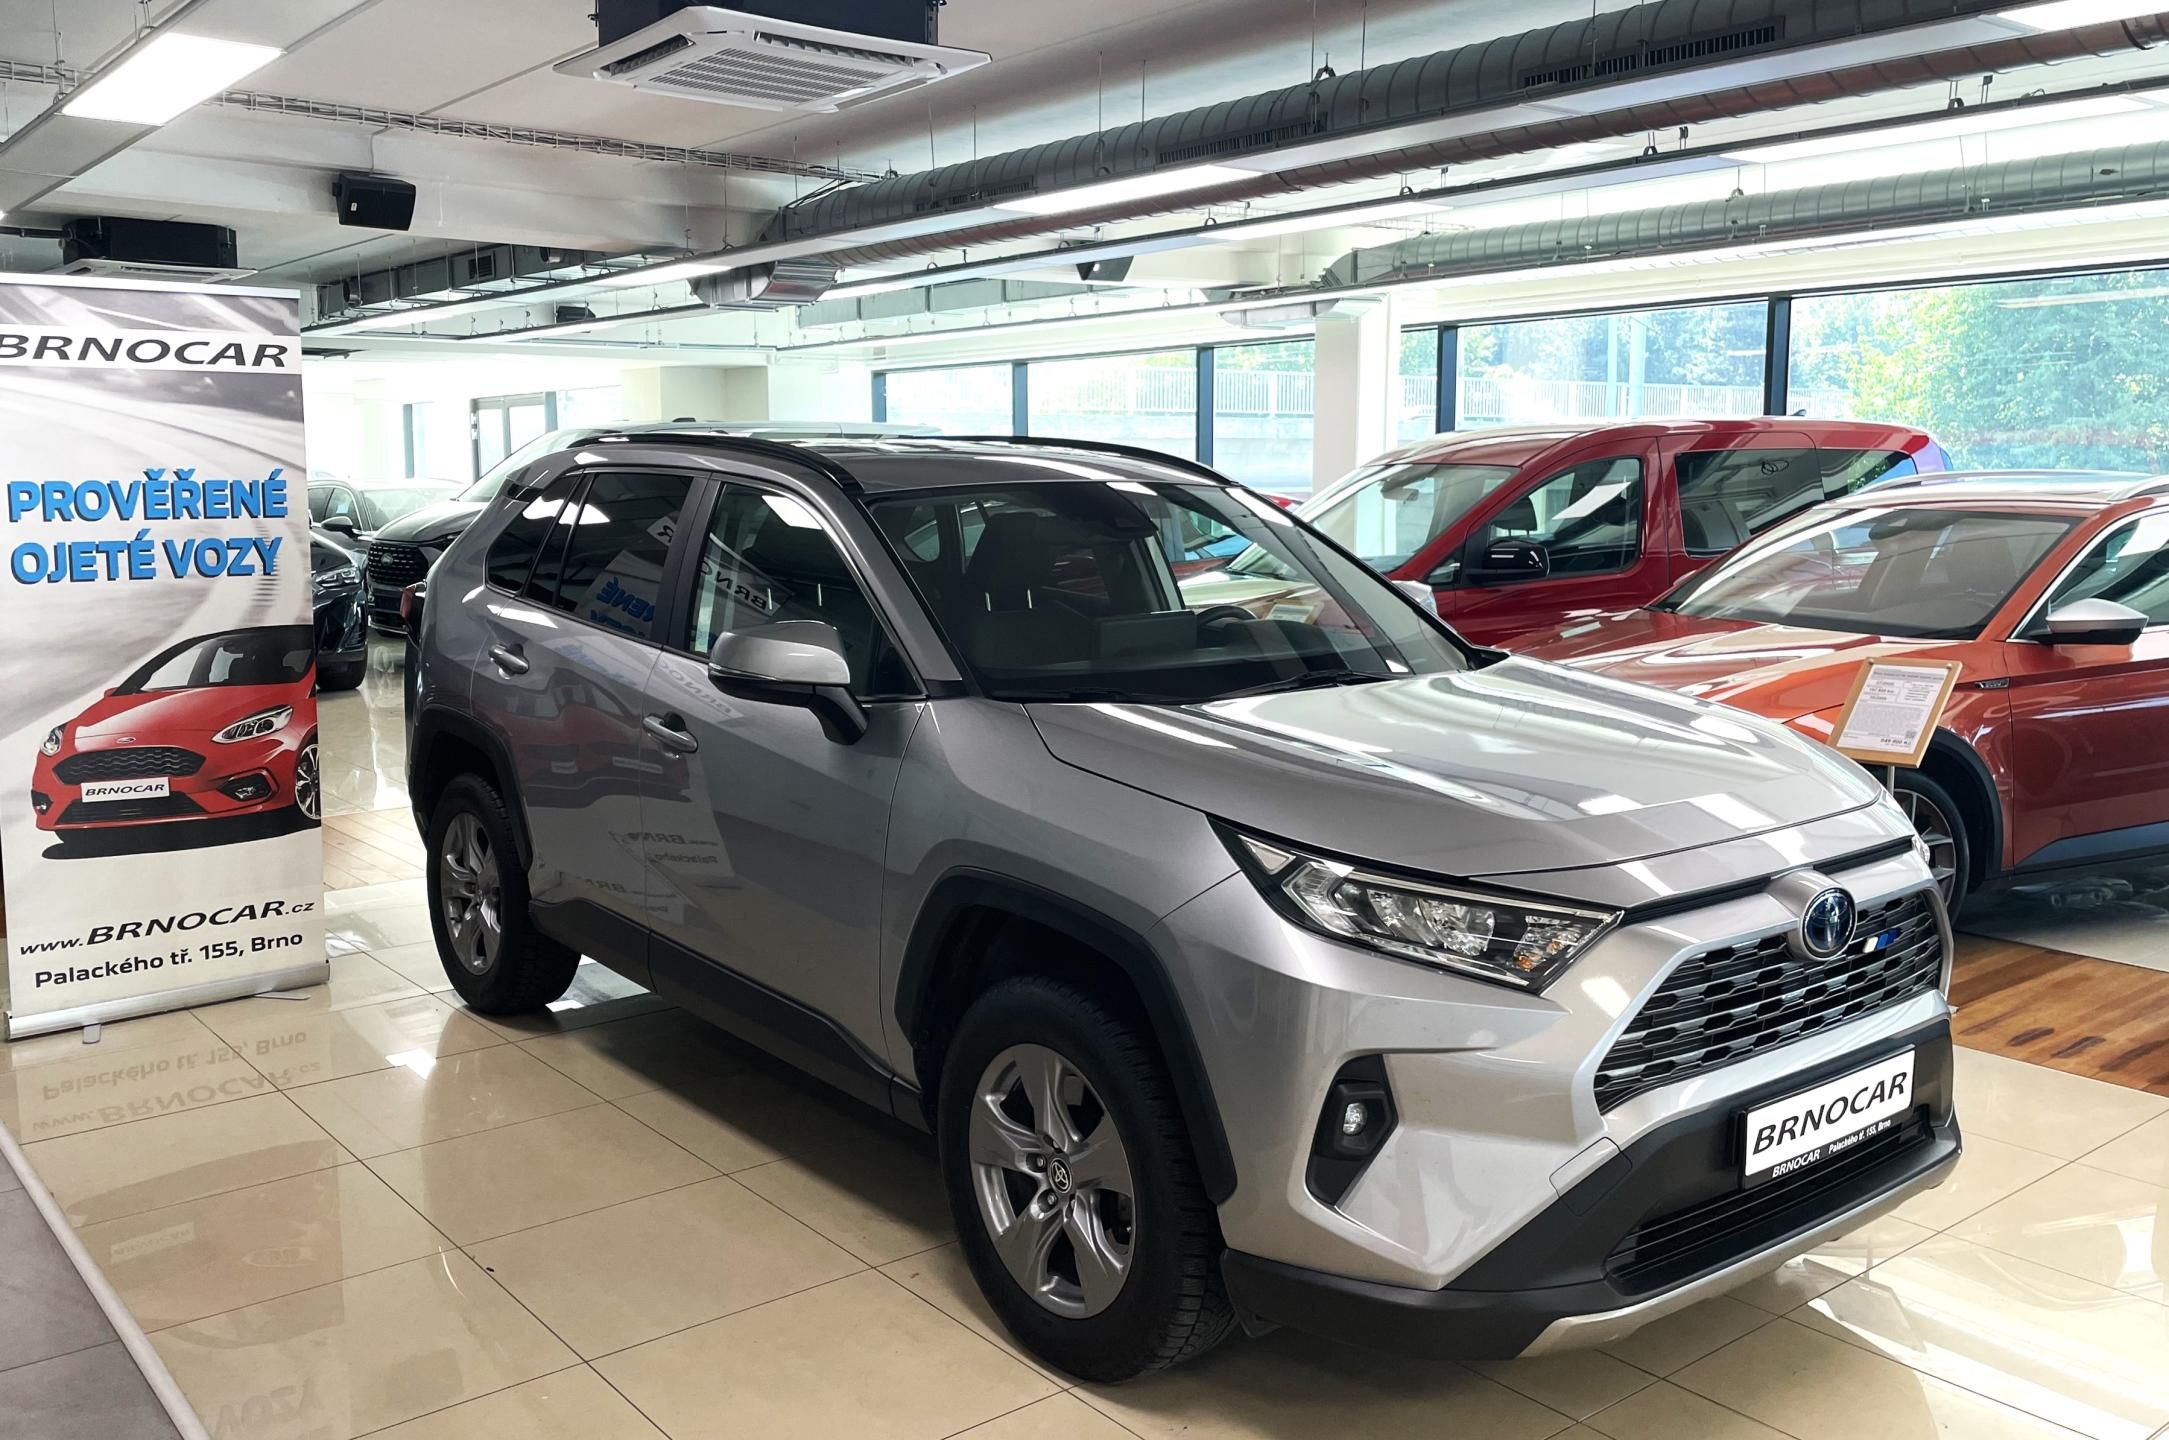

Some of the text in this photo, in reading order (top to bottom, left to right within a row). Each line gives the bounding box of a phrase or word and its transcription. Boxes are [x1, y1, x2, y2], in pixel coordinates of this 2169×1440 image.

[0, 334, 288, 367] BRNOCAR
[7, 468, 288, 522] PROVĚŘENÉ
[10, 528, 283, 584] OJETÉ VOZY
[85, 783, 165, 796] BRNOCAR
[20, 900, 315, 955] www.BRNOCAR.cz
[35, 933, 303, 988] Palackého tř. 155, Brno
[1753, 1071, 1907, 1155] BRNOCAR
[1772, 1149, 1821, 1178] BRNOCAR
[1877, 1119, 1891, 1132] Brno
